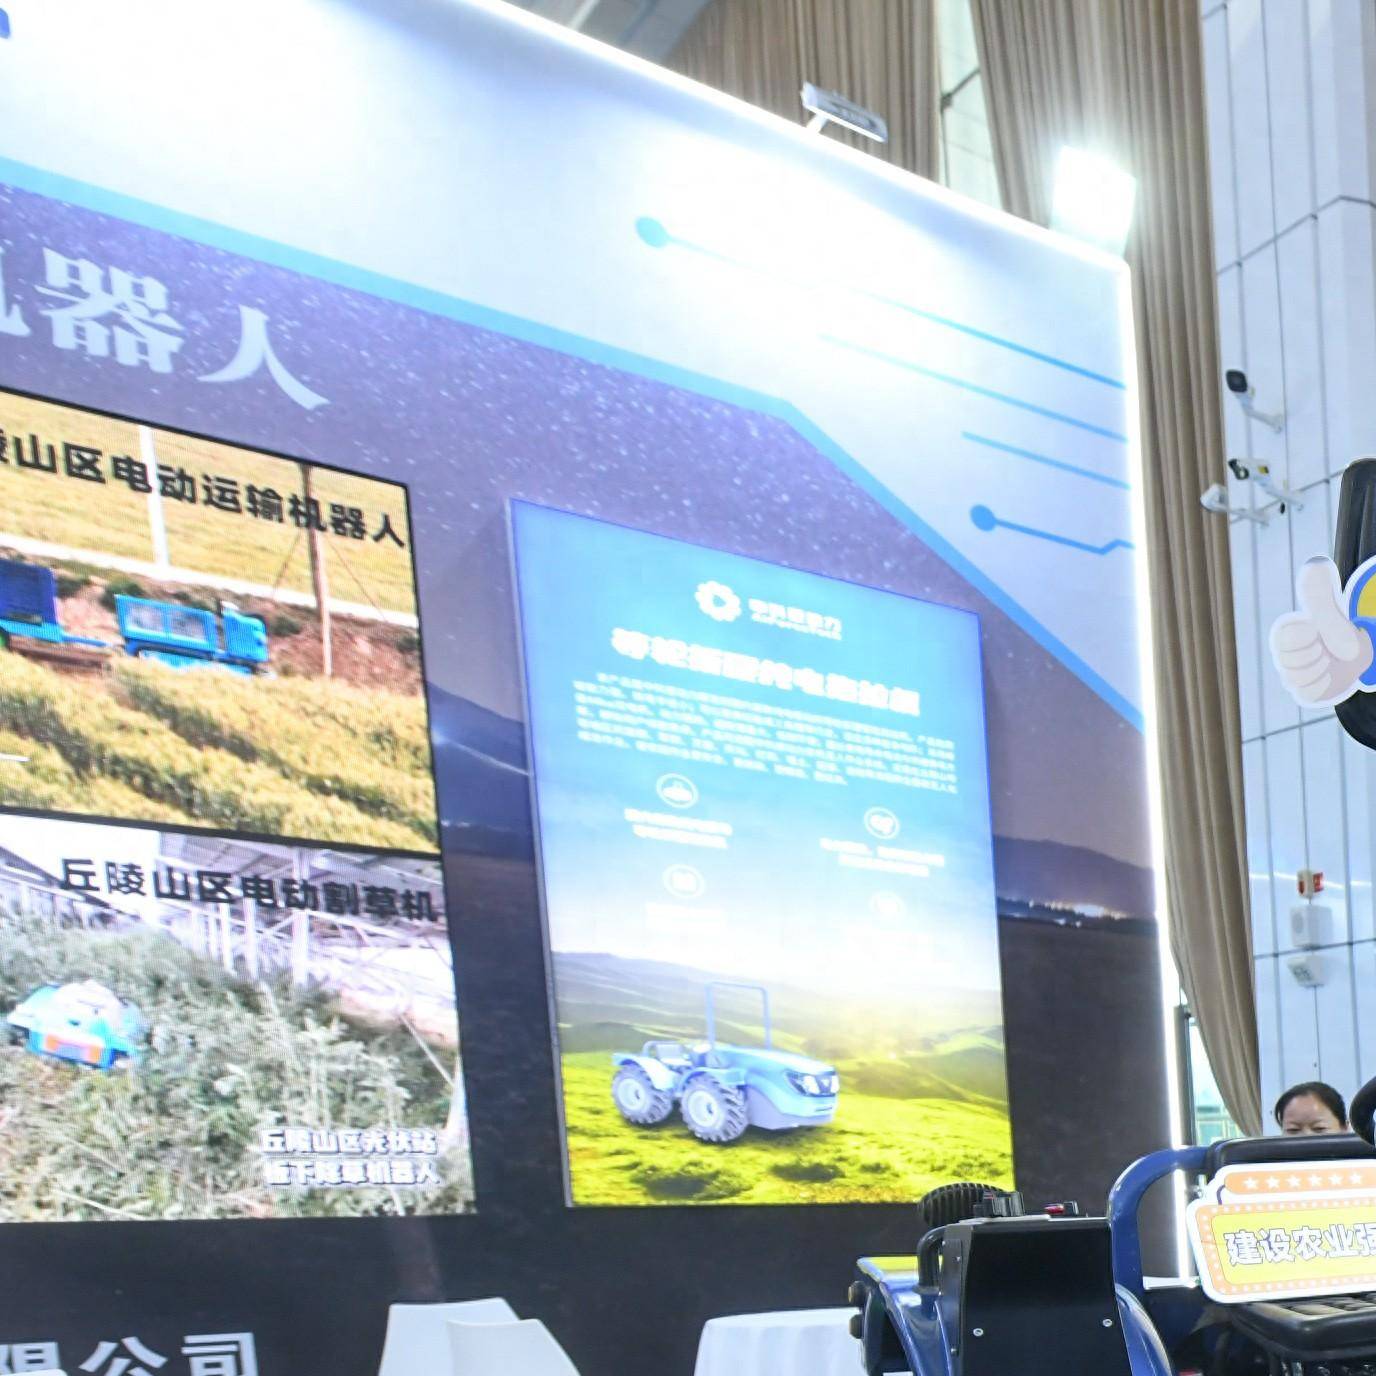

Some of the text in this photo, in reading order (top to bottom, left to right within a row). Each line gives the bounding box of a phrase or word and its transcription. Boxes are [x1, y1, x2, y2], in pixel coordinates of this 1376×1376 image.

[60, 858, 438, 922] 丘陵山区电动割草机
